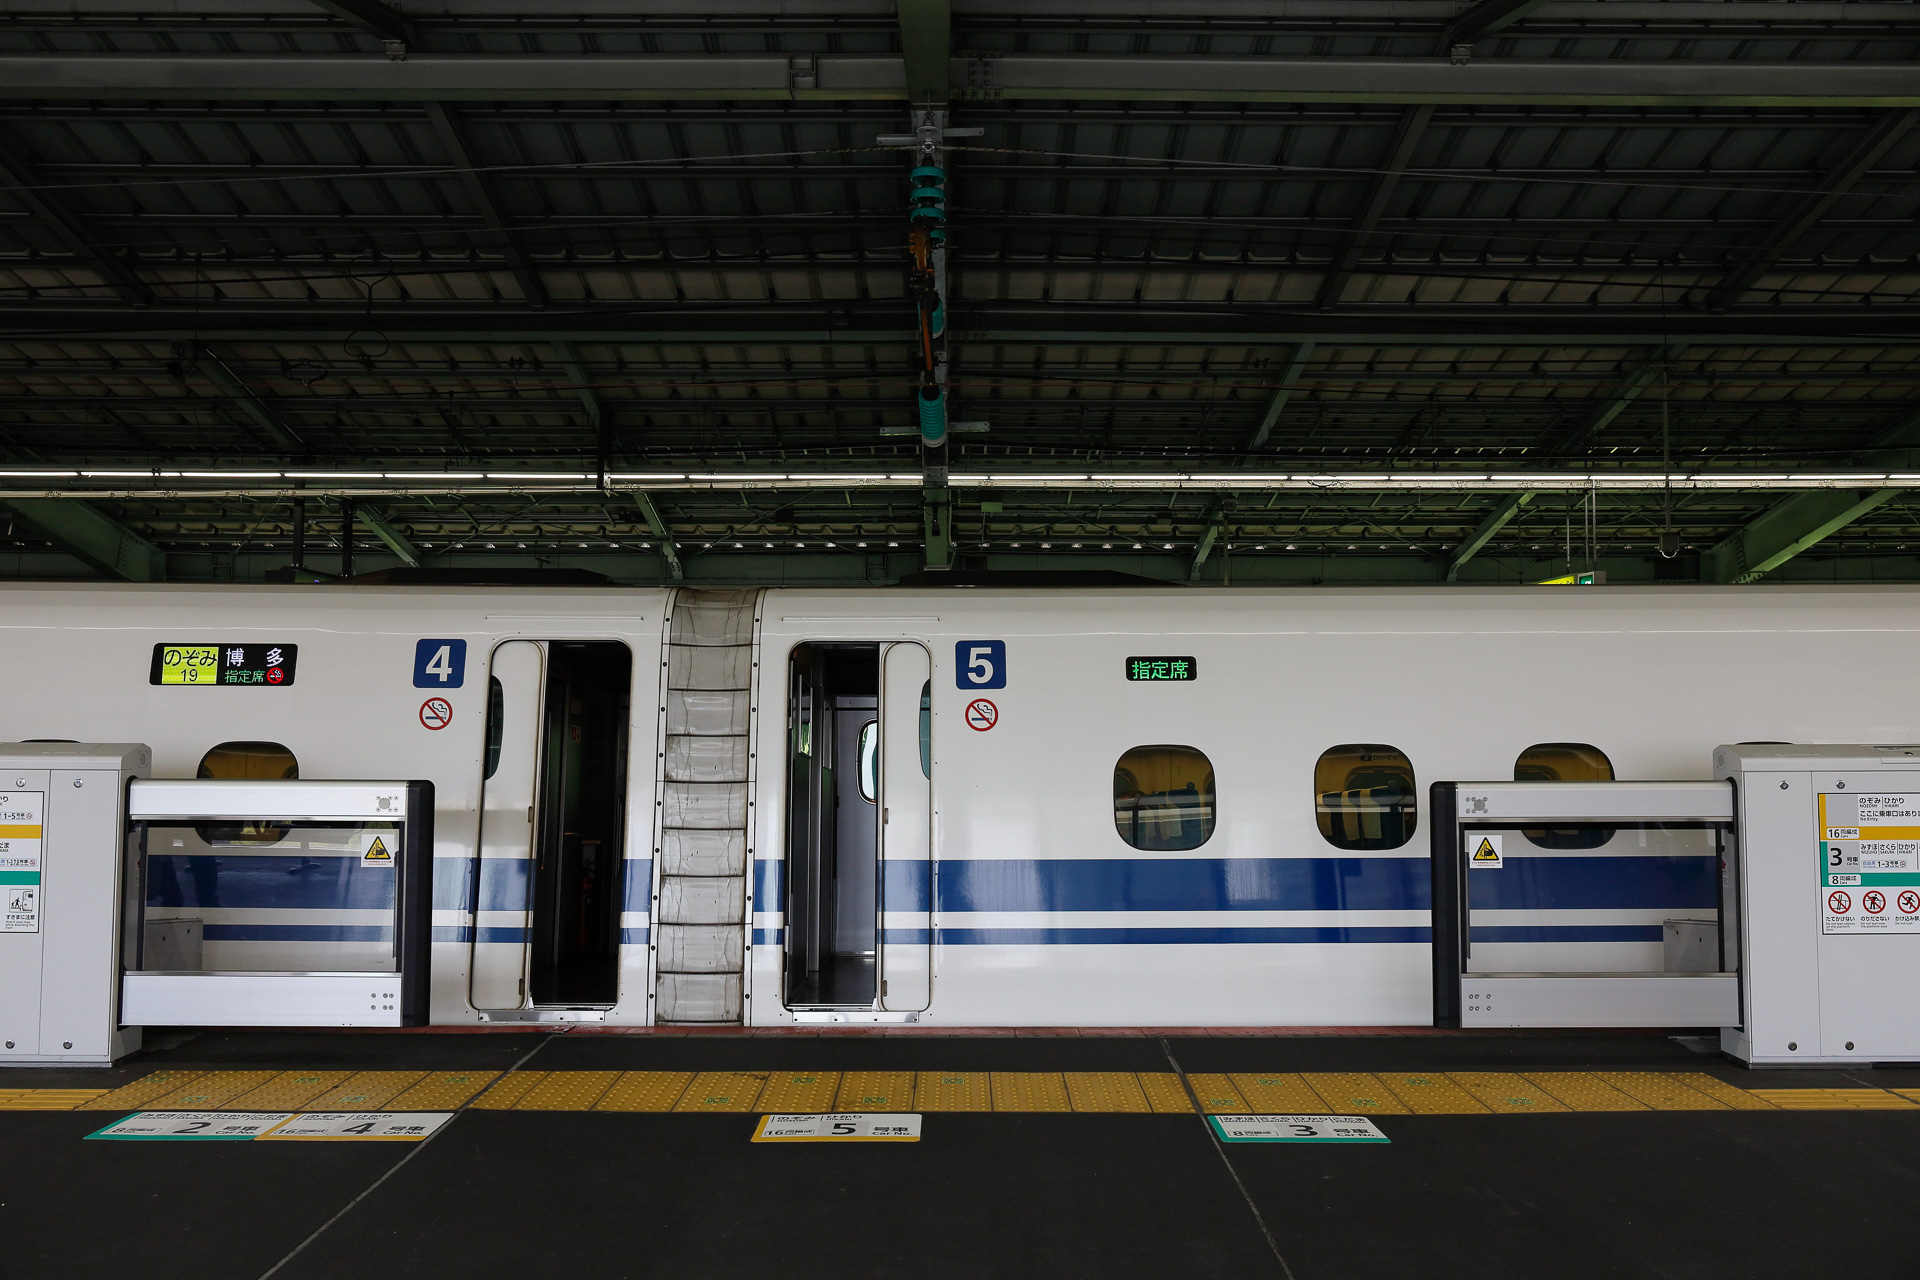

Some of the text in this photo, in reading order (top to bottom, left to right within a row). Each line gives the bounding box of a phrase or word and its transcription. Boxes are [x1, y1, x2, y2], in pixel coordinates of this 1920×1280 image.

[164, 649, 218, 667] のぞみ
[425, 645, 453, 682] 4
[967, 647, 994, 684] 5
[1132, 660, 1189, 680] 指定席
[180, 668, 198, 682] 19
[225, 670, 265, 684] 指定席
[1828, 829, 1840, 838] 16
[1830, 848, 1842, 866] 3
[1832, 876, 1838, 884] 8
[172, 1122, 212, 1134] 2
[342, 1122, 377, 1134] 4
[831, 1123, 857, 1135] 5
[1288, 1124, 1318, 1136] 3
